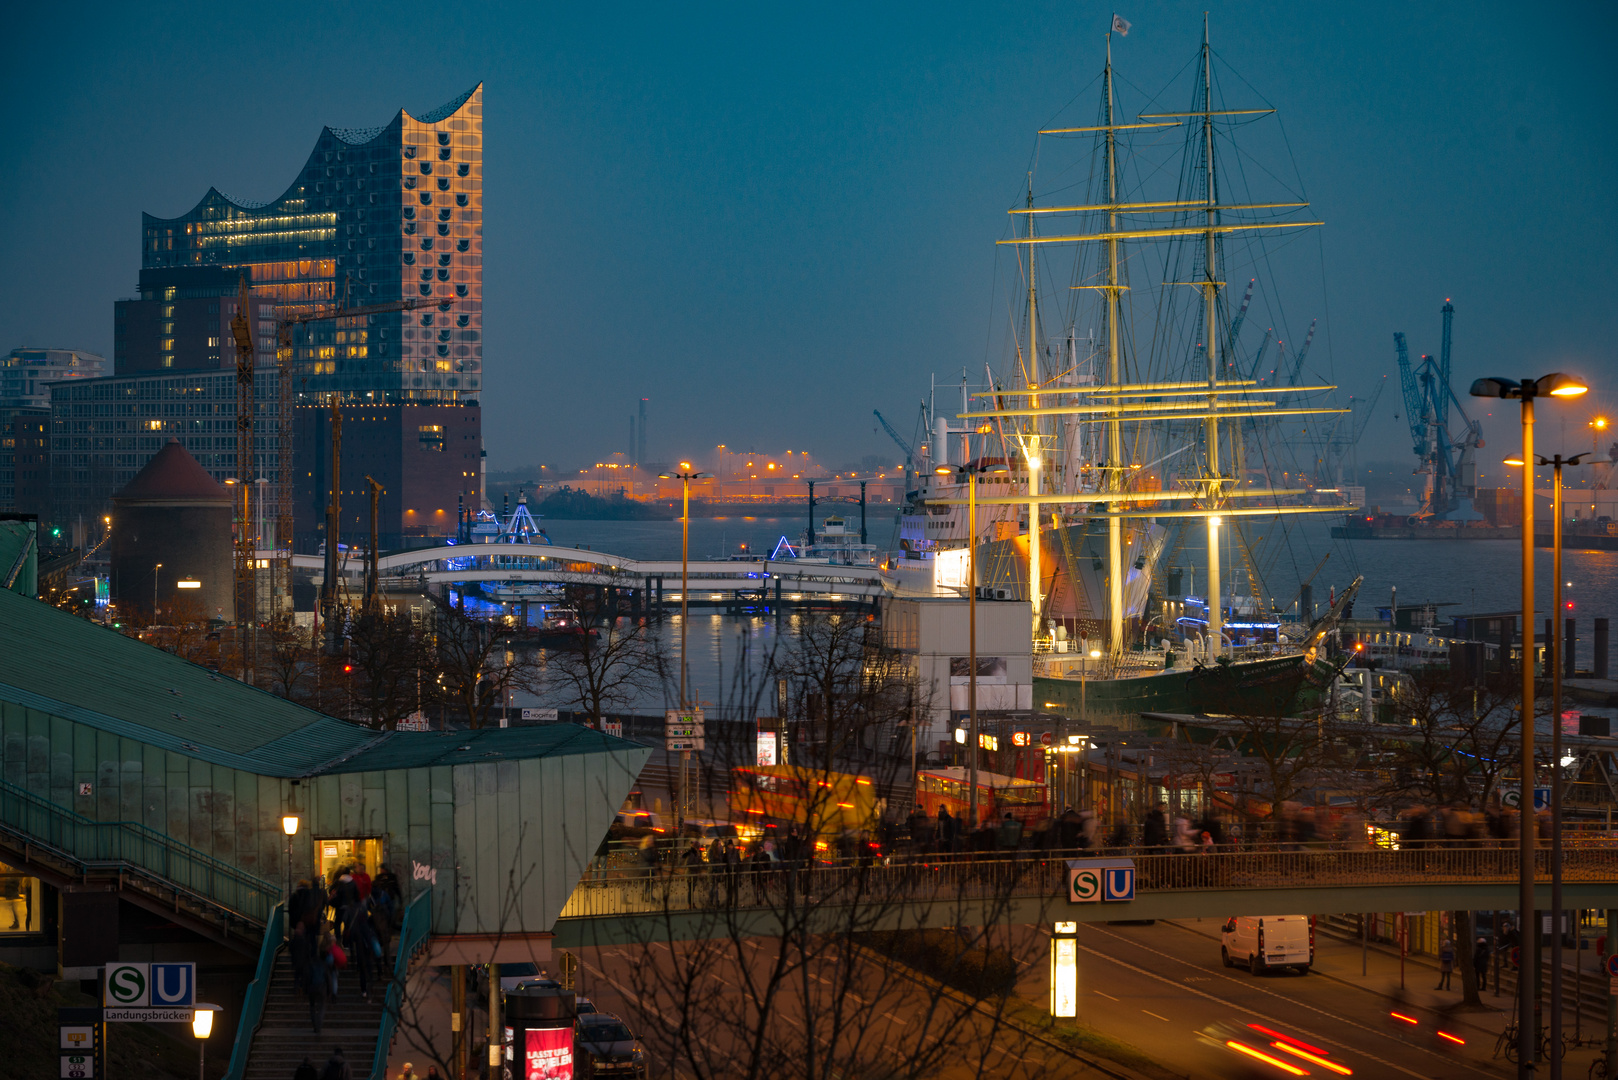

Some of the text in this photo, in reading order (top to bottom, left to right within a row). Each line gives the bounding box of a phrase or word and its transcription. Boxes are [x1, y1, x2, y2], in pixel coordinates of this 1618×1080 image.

[1076, 870, 1131, 898] S U
[115, 966, 187, 1002] S U
[105, 1010, 191, 1022] Landungsbrücken
[526, 1048, 553, 1060] LASST
[531, 1053, 572, 1069] SPIELEN
